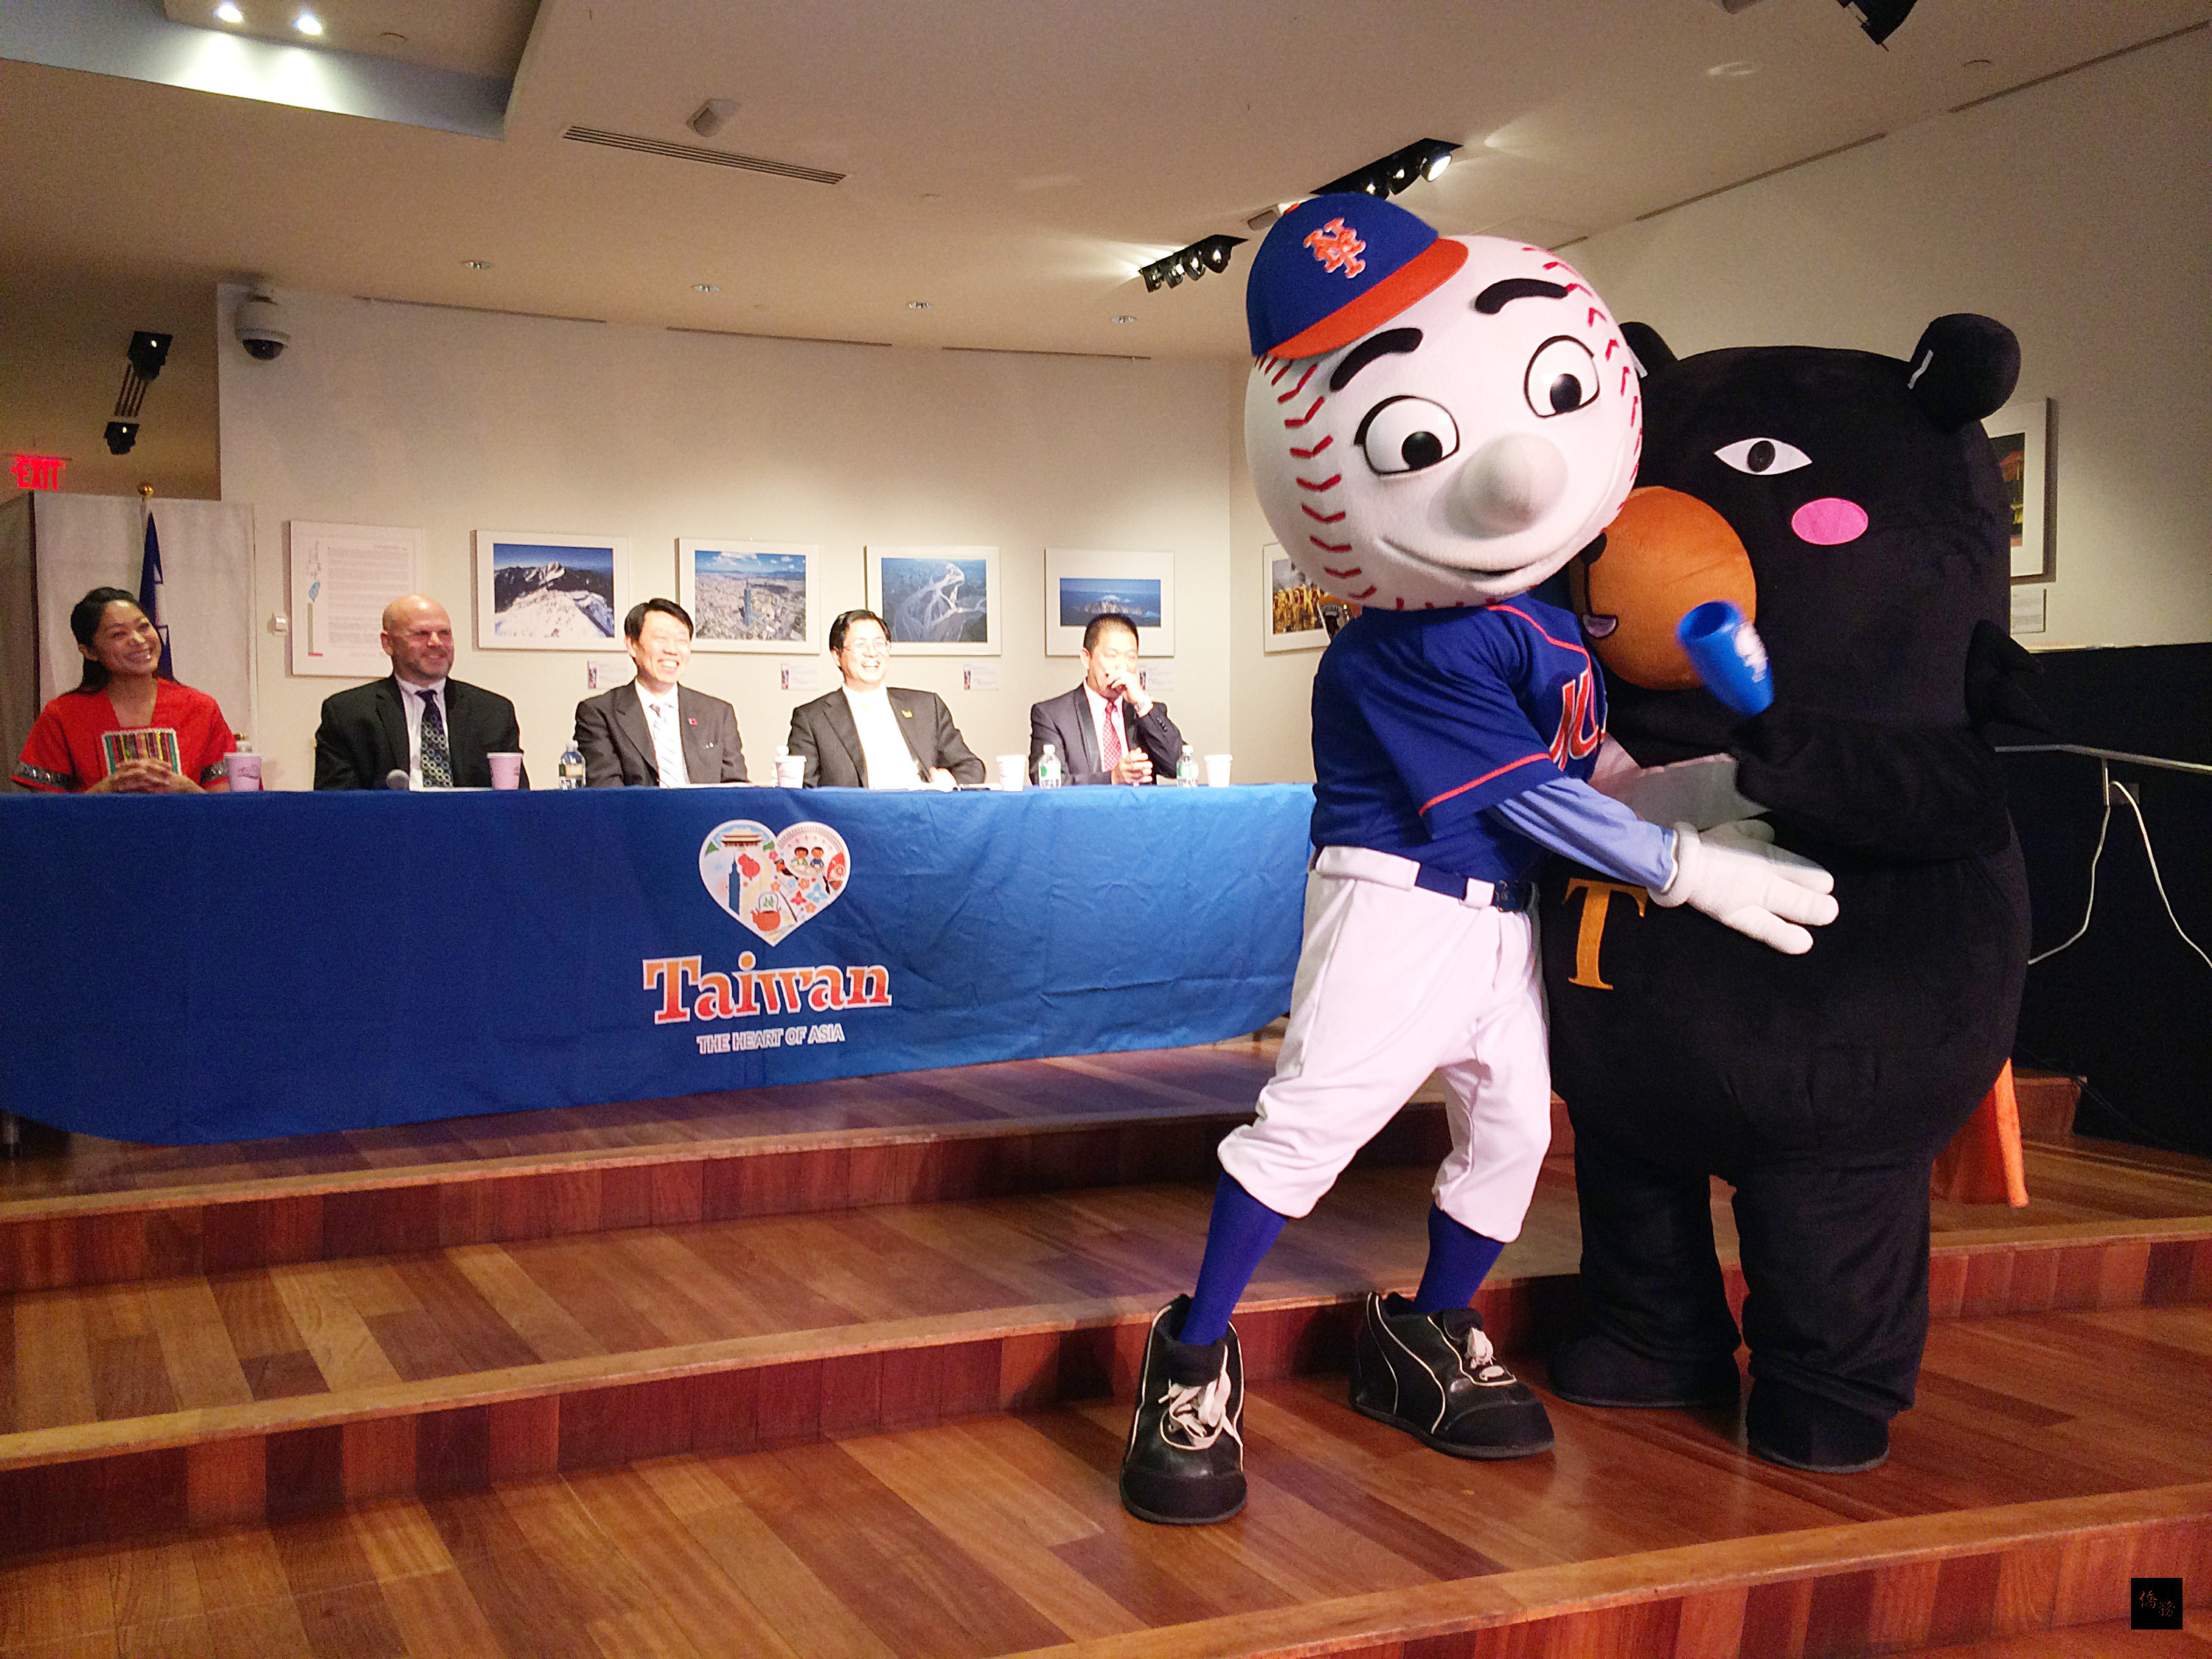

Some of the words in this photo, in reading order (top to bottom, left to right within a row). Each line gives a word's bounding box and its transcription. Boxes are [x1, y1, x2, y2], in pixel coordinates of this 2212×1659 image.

[16, 456, 61, 491] EXIT
[642, 950, 892, 1025] Taiwan
[696, 1033, 731, 1054] THE
[731, 1028, 784, 1051] HEART
[785, 1026, 807, 1046] OF
[807, 1023, 845, 1044] ASIA
